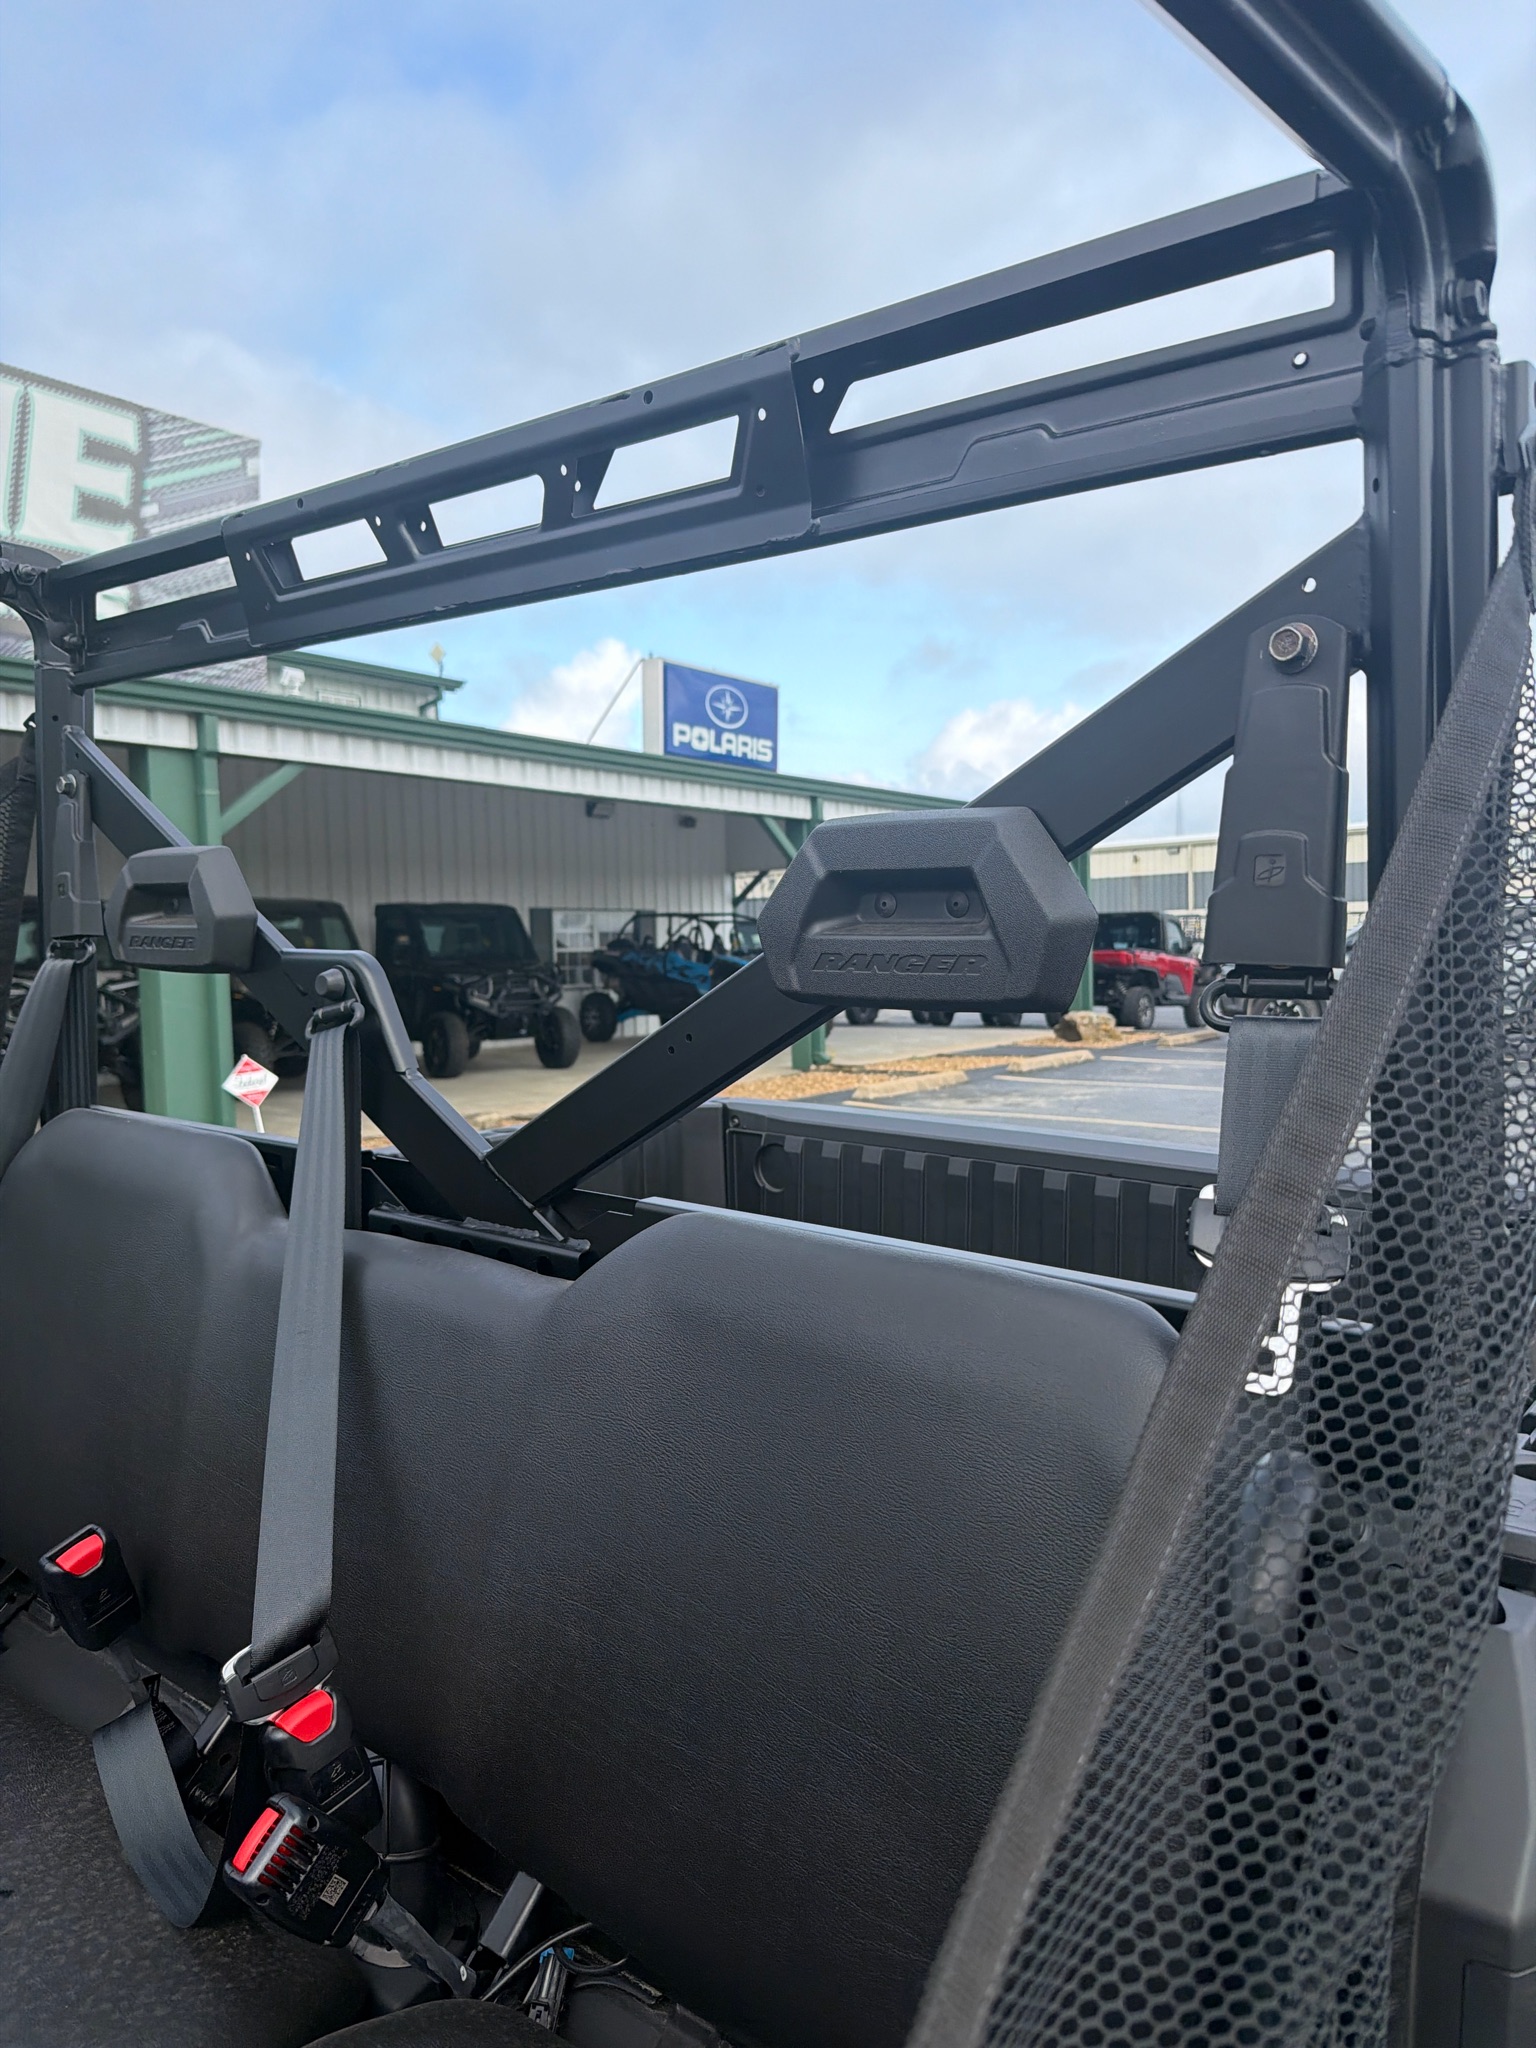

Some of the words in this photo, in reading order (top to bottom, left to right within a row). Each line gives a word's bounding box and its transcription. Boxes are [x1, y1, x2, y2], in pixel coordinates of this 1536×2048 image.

[0, 378, 140, 556] E
[672, 721, 774, 763] POLARIS
[128, 935, 196, 951] RANGER
[811, 952, 989, 976] RANGER
